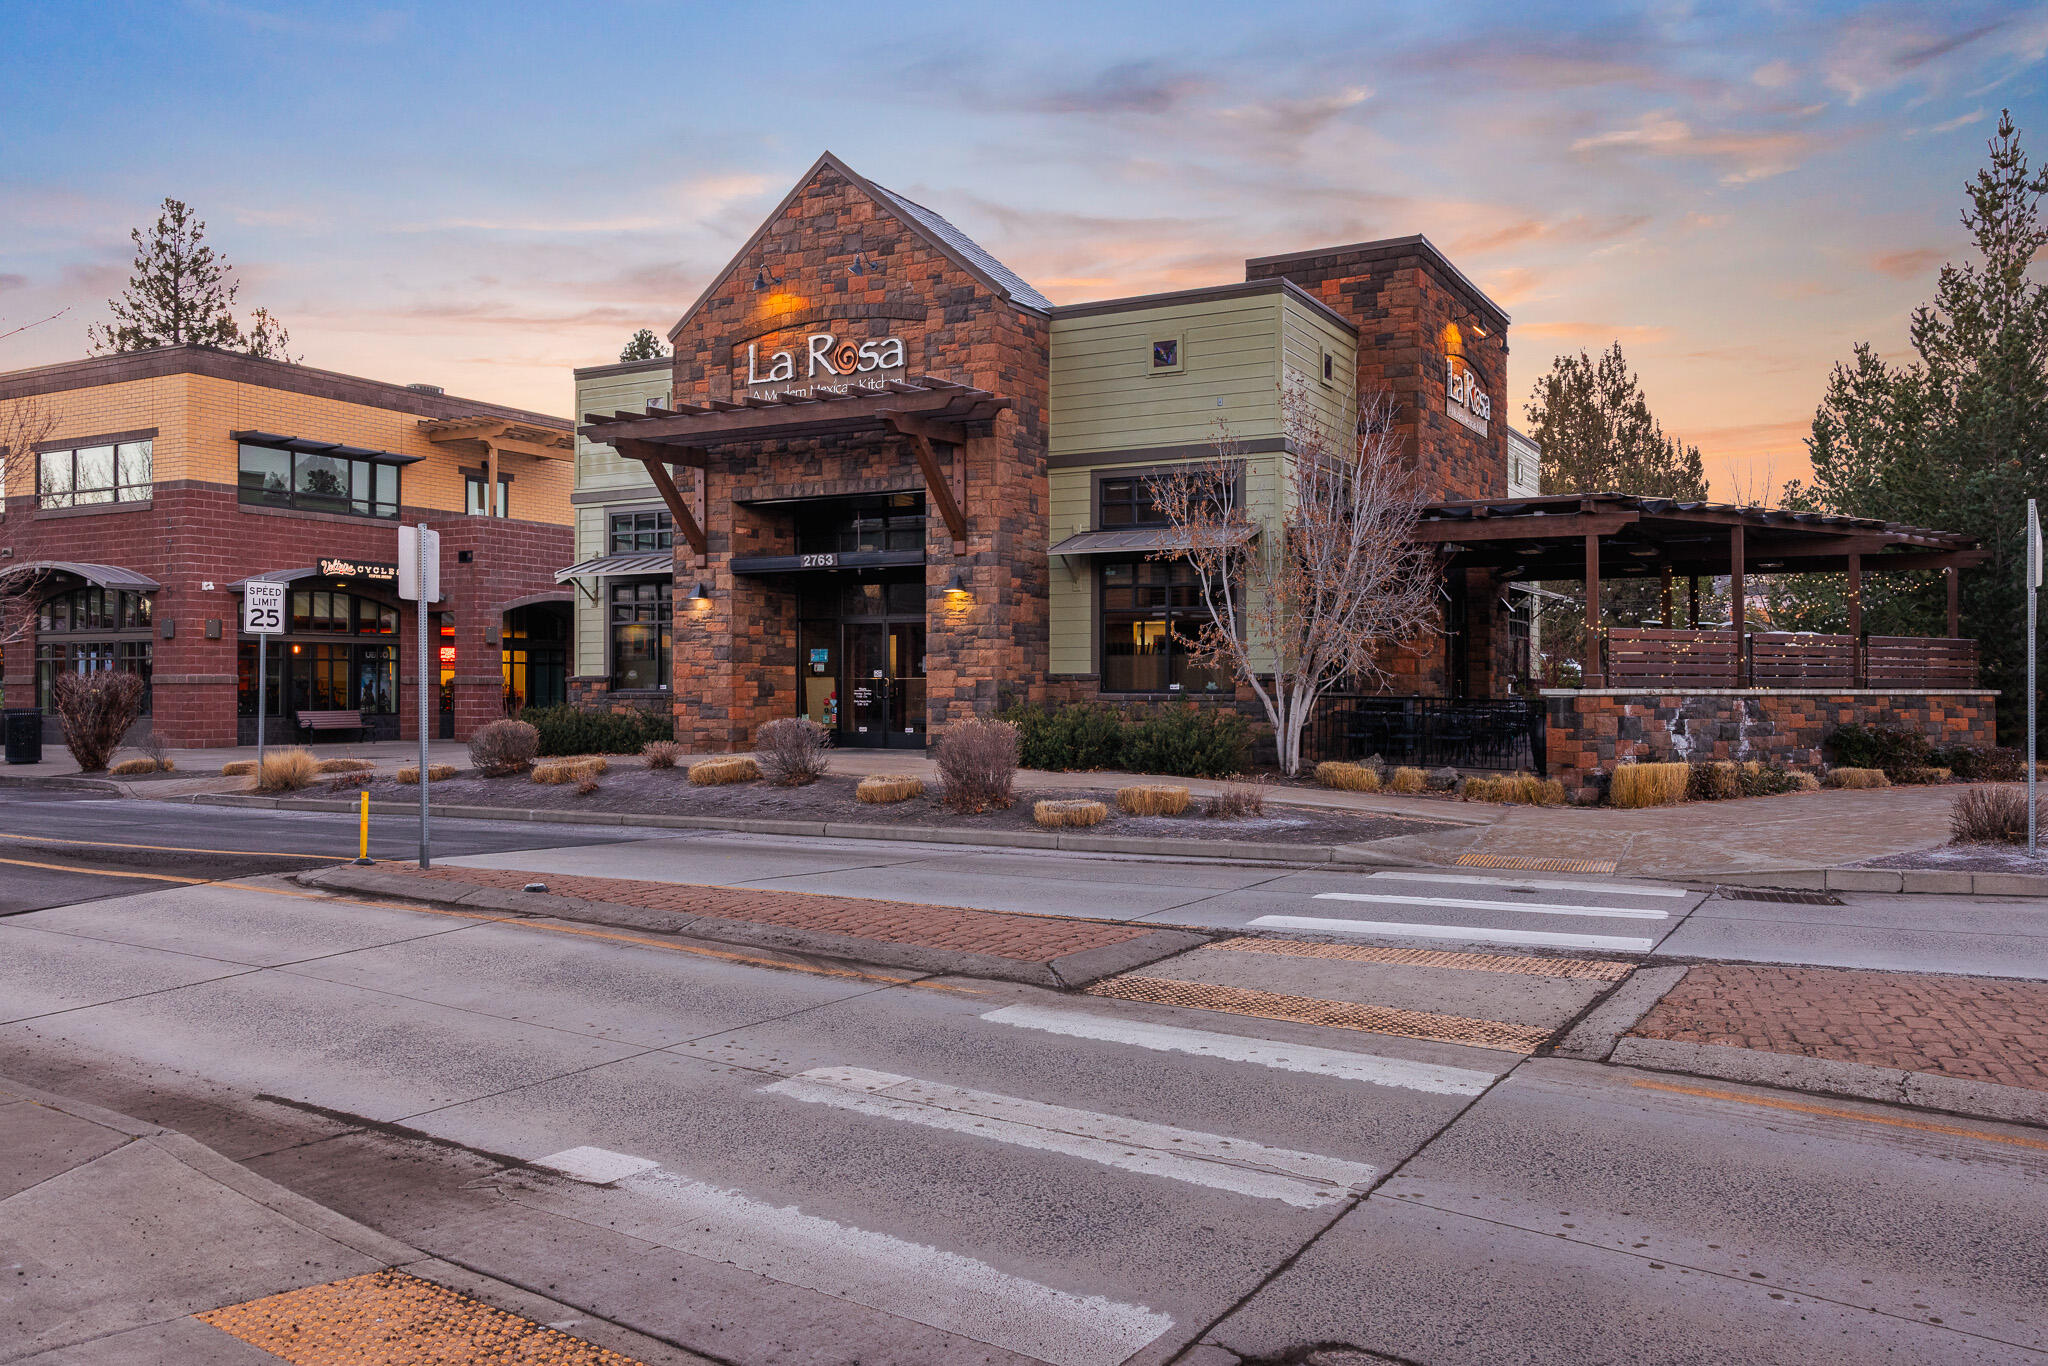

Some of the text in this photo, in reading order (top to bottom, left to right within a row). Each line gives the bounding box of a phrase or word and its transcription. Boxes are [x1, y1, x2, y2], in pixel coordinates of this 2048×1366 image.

[748, 334, 904, 384] La Rosa
[753, 389, 761, 400] A
[810, 377, 854, 396] Mexica
[1446, 357, 1491, 421] La Rosa
[803, 554, 834, 567] 2763
[249, 586, 282, 597] SPEED
[252, 597, 278, 607] LIMIT
[250, 608, 280, 628] 25
